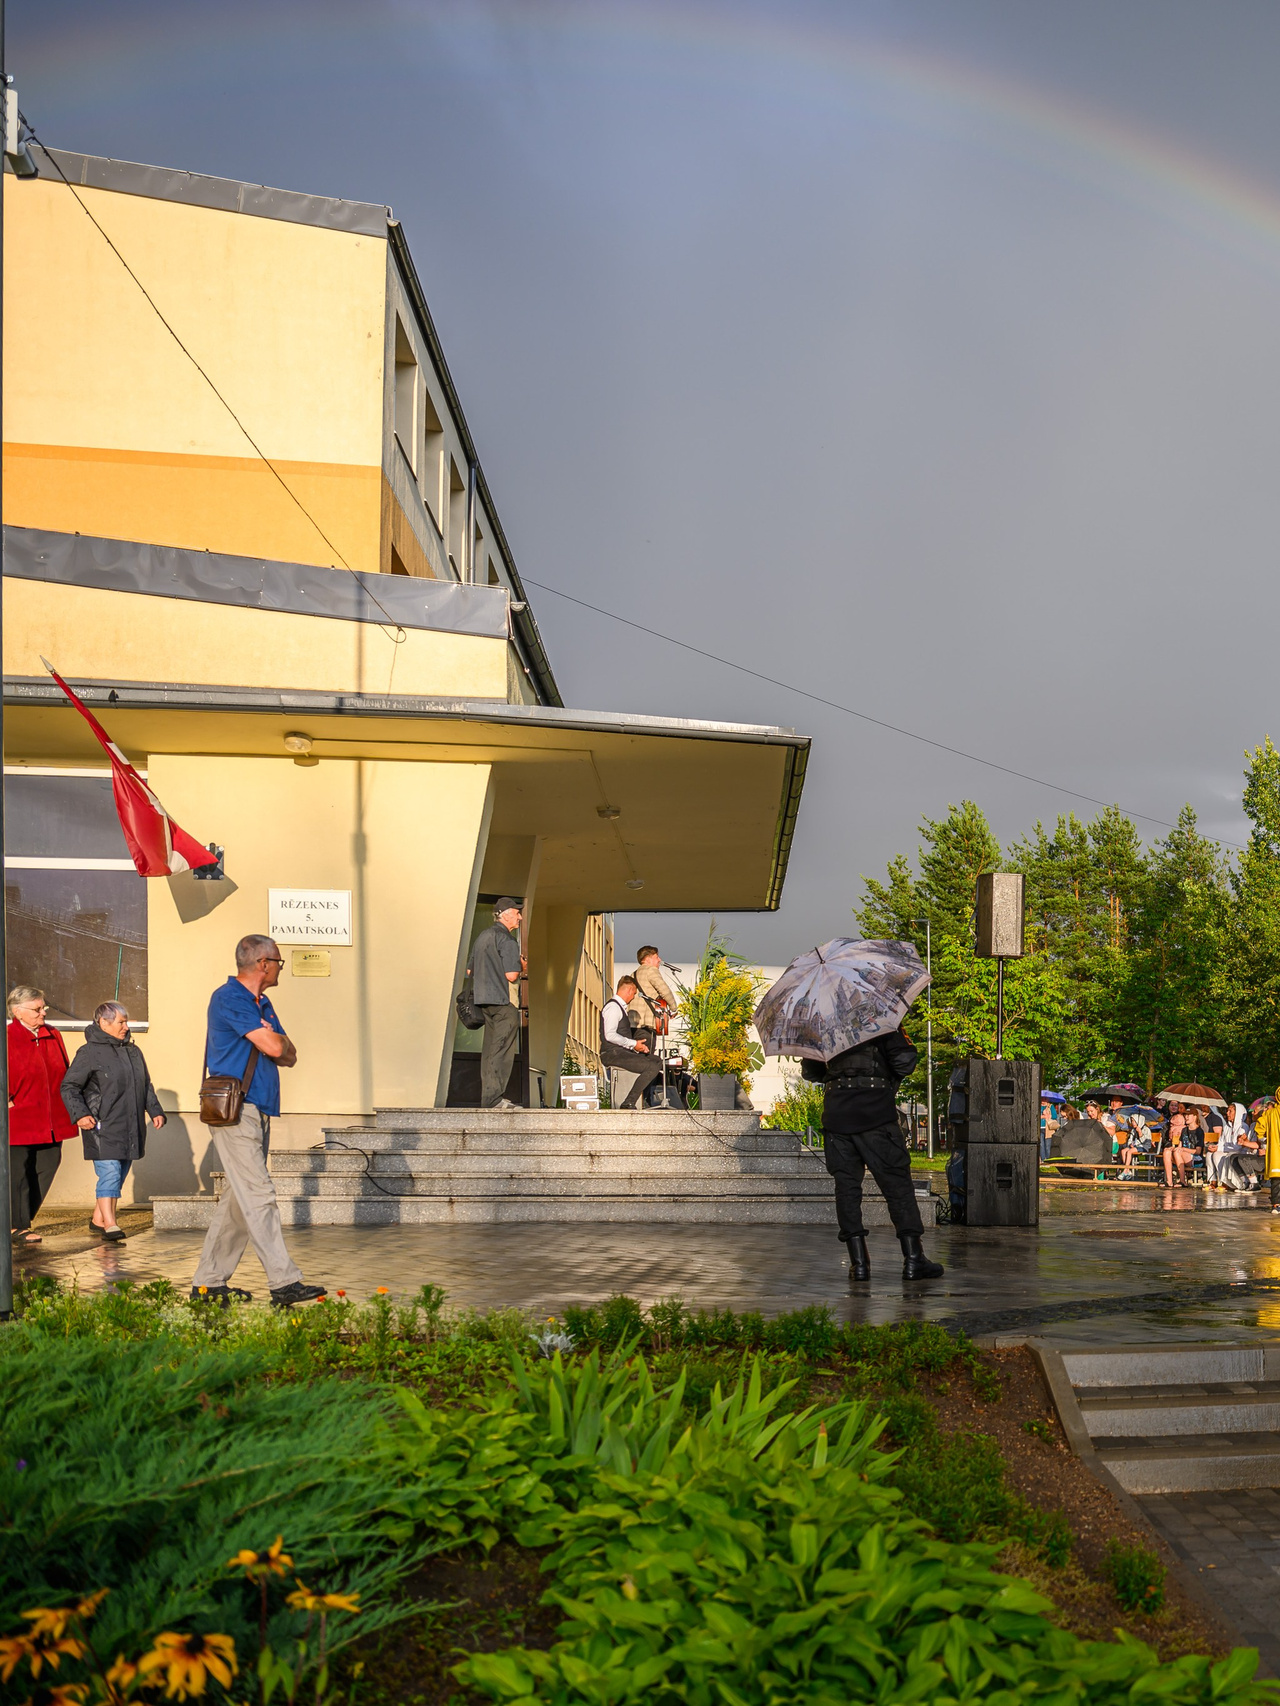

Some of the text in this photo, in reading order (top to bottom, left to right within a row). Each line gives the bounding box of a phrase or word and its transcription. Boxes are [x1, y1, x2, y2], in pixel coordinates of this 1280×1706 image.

[281, 899, 339, 909] RĒZEKNES
[306, 913, 314, 922] 5.
[271, 925, 348, 935] PAMATSKOLA
